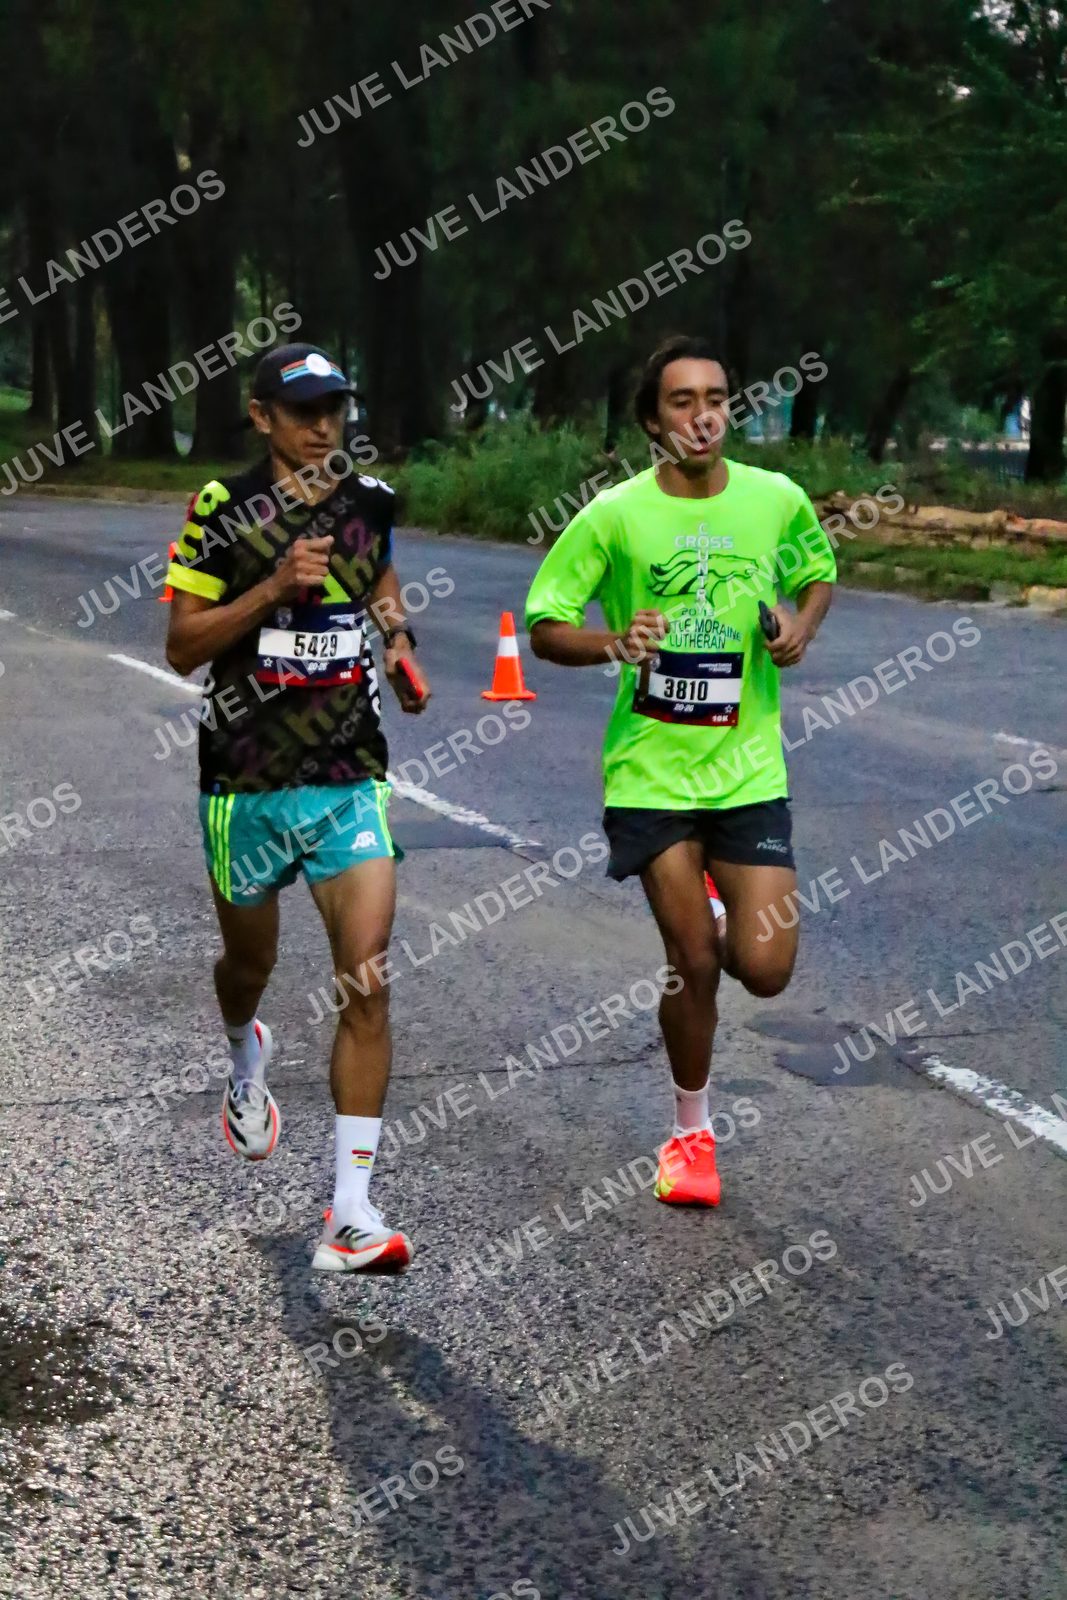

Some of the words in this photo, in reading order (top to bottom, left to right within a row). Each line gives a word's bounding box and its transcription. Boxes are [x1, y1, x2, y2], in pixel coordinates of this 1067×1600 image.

[675, 534, 734, 549] CROSS
[669, 633, 726, 649] LUTHERAN
[695, 618, 742, 641] MORAINE
[293, 633, 338, 658] 5429
[664, 678, 709, 702] 3810
